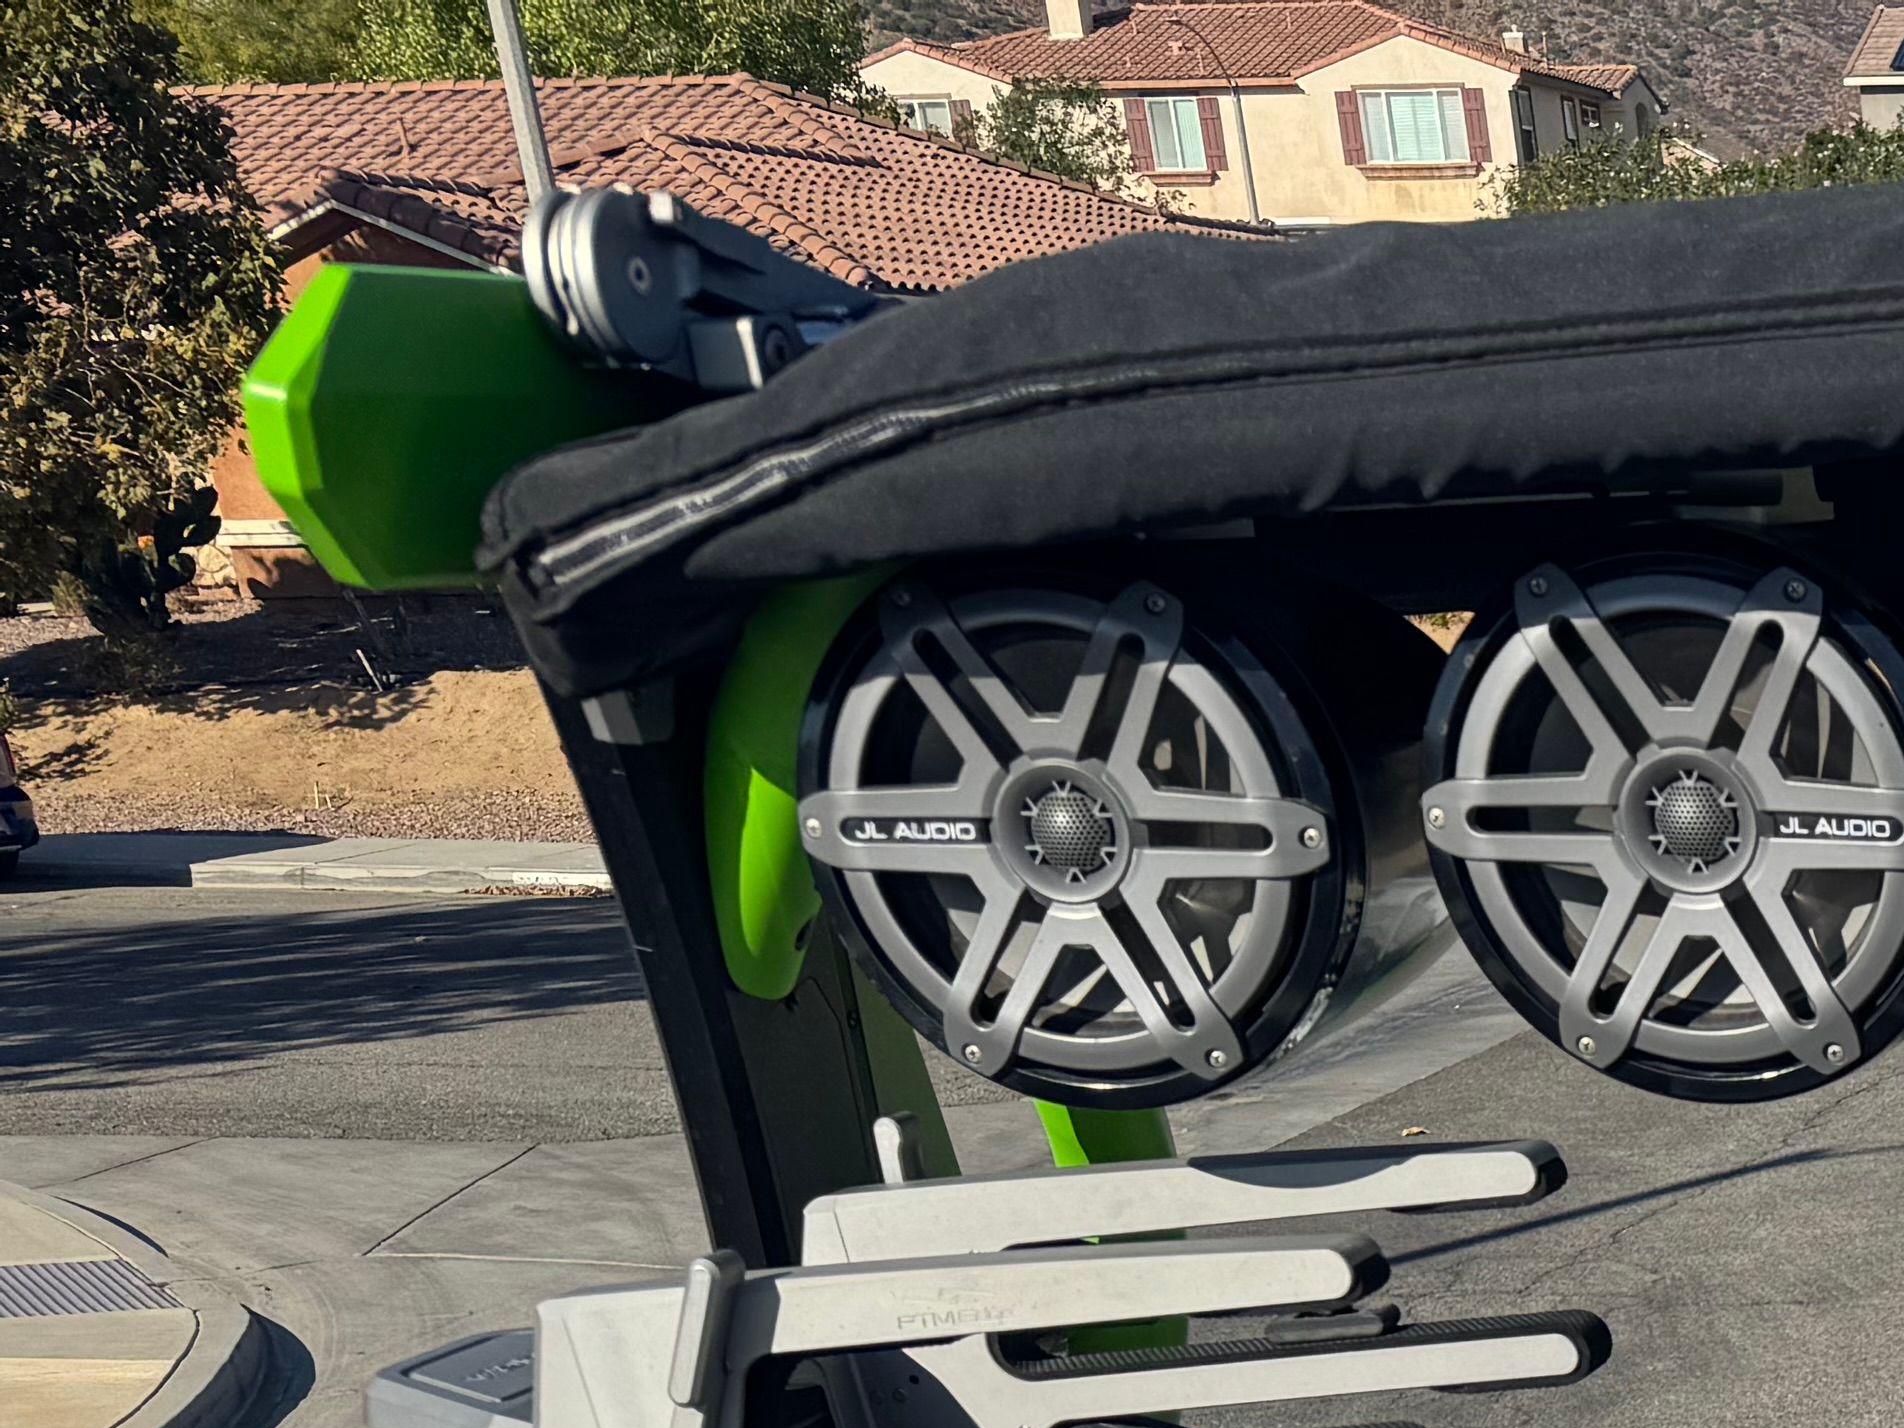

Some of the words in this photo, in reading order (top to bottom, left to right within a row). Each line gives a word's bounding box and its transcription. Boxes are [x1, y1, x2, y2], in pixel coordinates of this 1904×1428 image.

[855, 821, 888, 840] JL
[894, 821, 977, 841] AUDIO
[1779, 816, 1809, 834] JL
[1814, 817, 1891, 838] AUDIO
